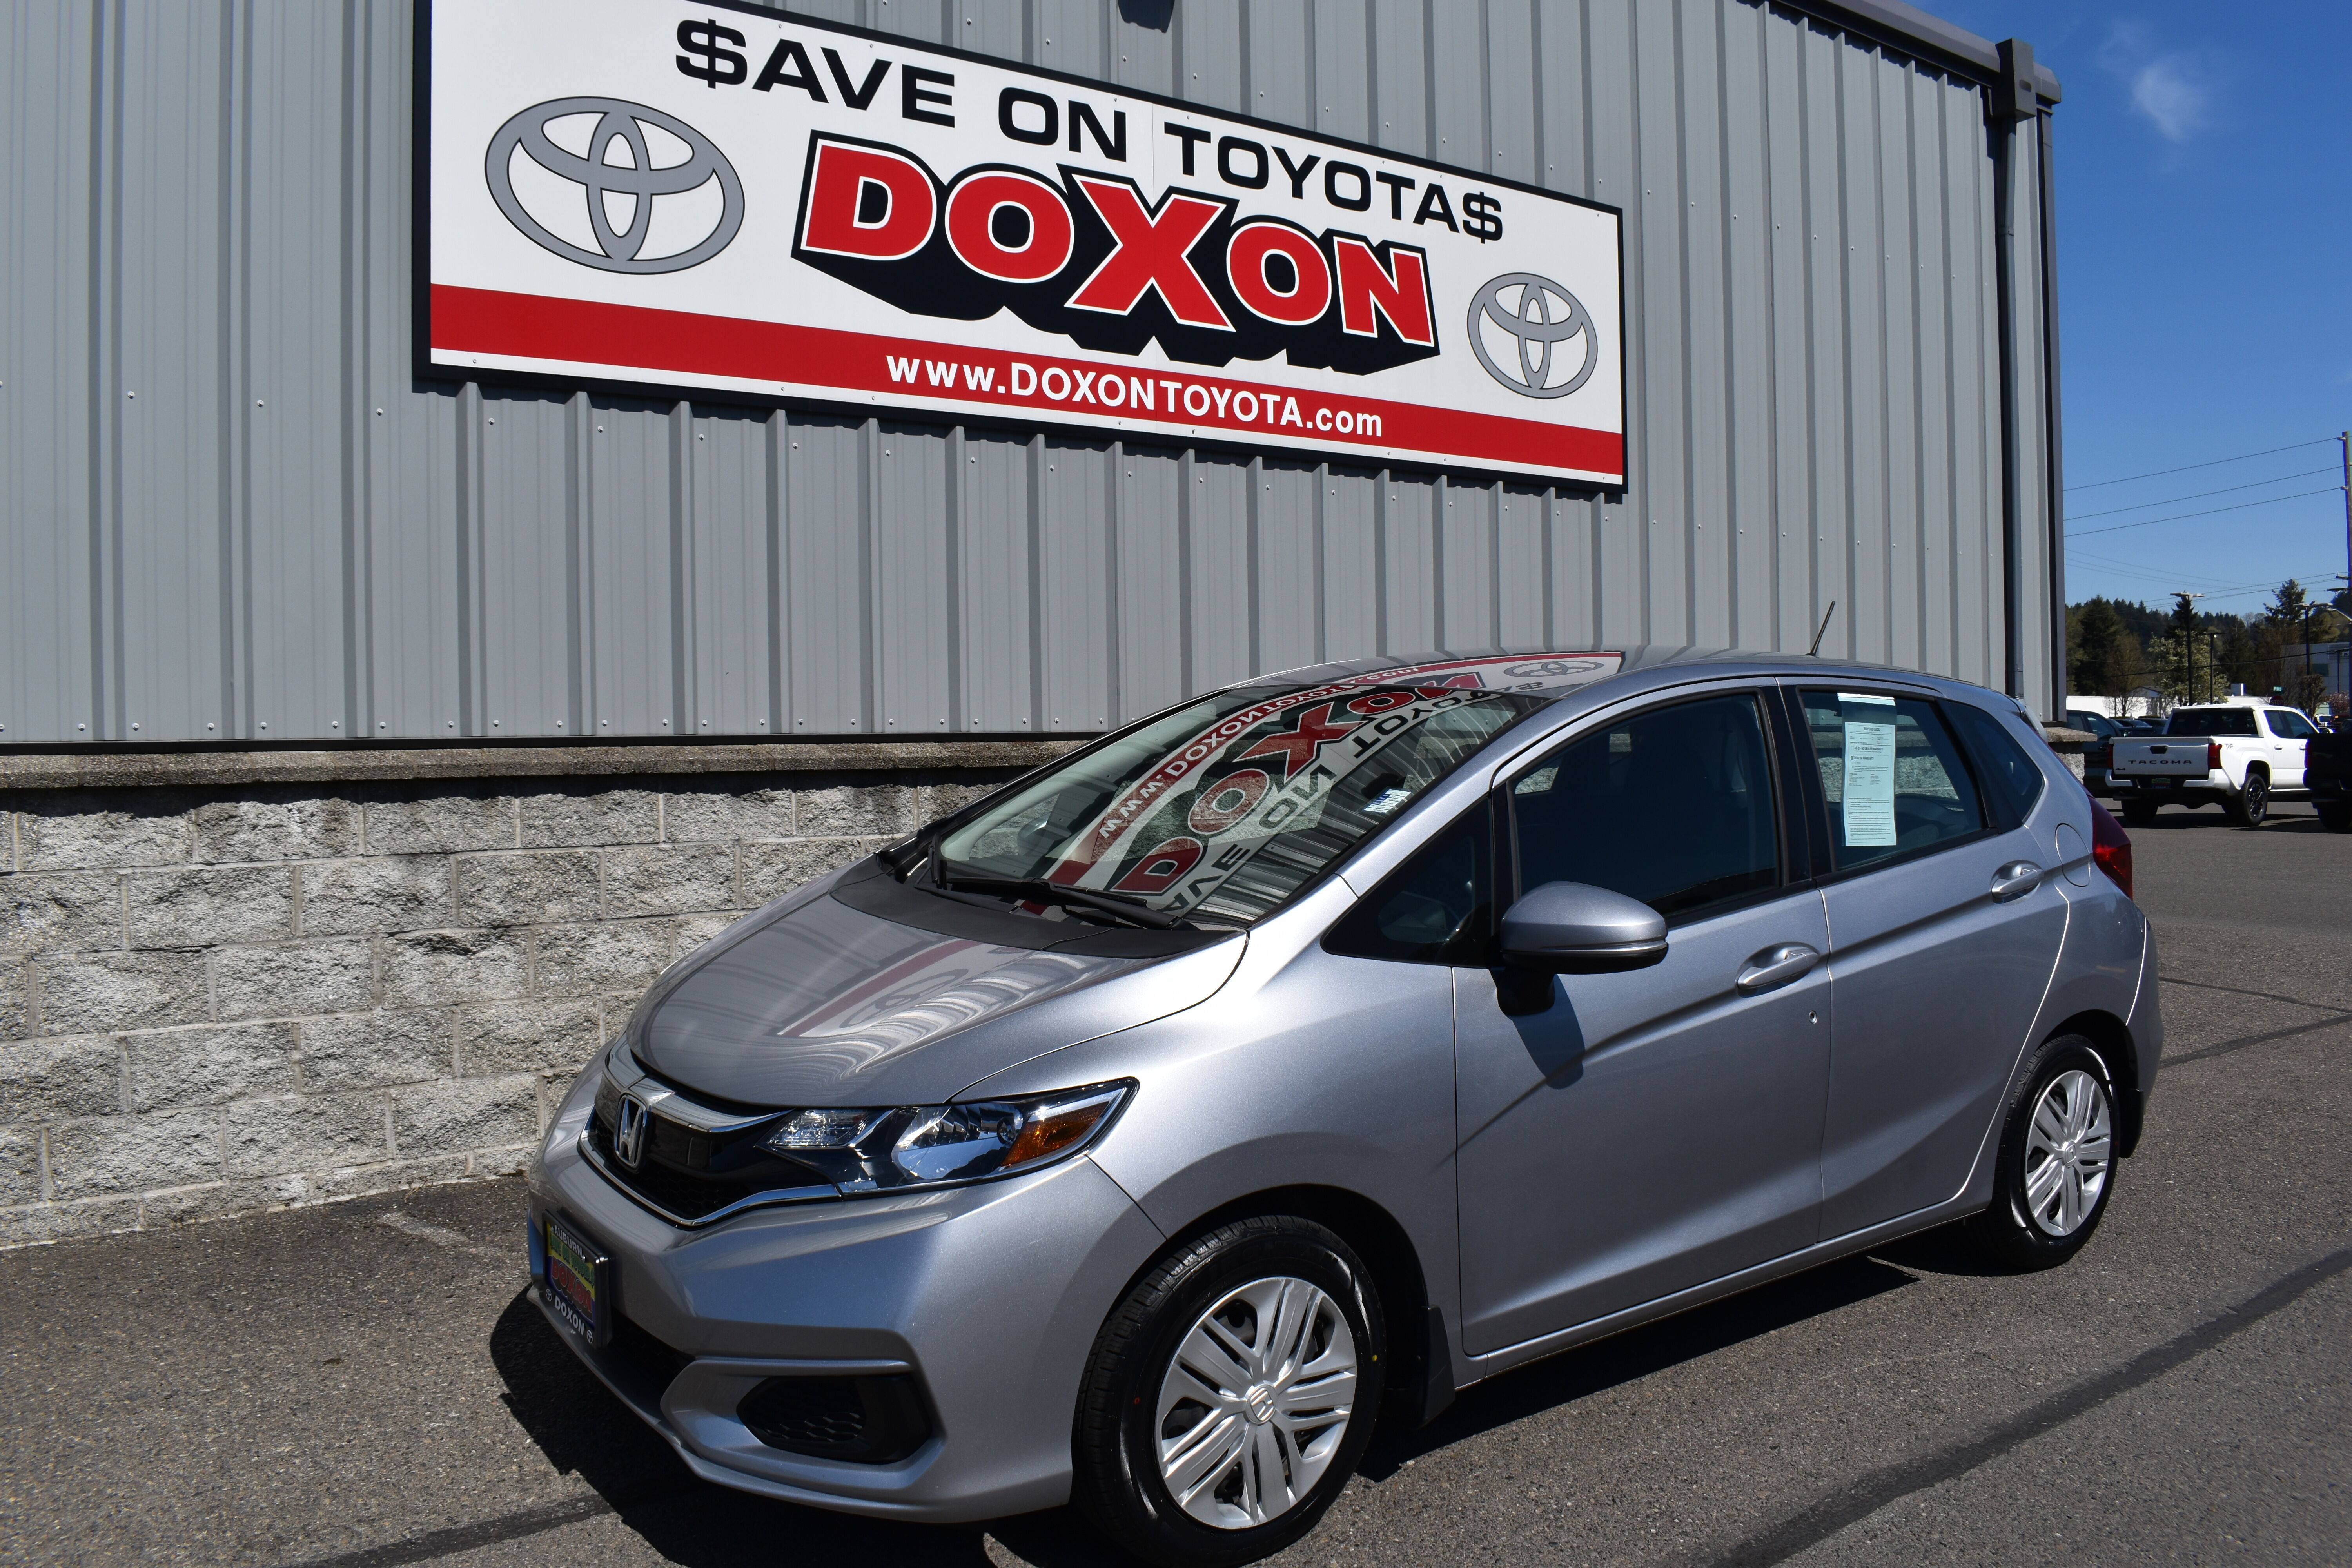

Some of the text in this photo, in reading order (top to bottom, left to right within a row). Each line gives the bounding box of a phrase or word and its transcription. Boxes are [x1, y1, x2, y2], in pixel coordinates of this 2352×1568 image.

[675, 18, 1504, 245] $AVE ON TOYOTA$
[798, 135, 1436, 349] DOXON
[886, 354, 1383, 437] www.DOXONTOYOTA.com
[555, 1224, 583, 1257] AUBURN
[551, 1256, 593, 1313] DOXON
[554, 1295, 584, 1336] DOXON
